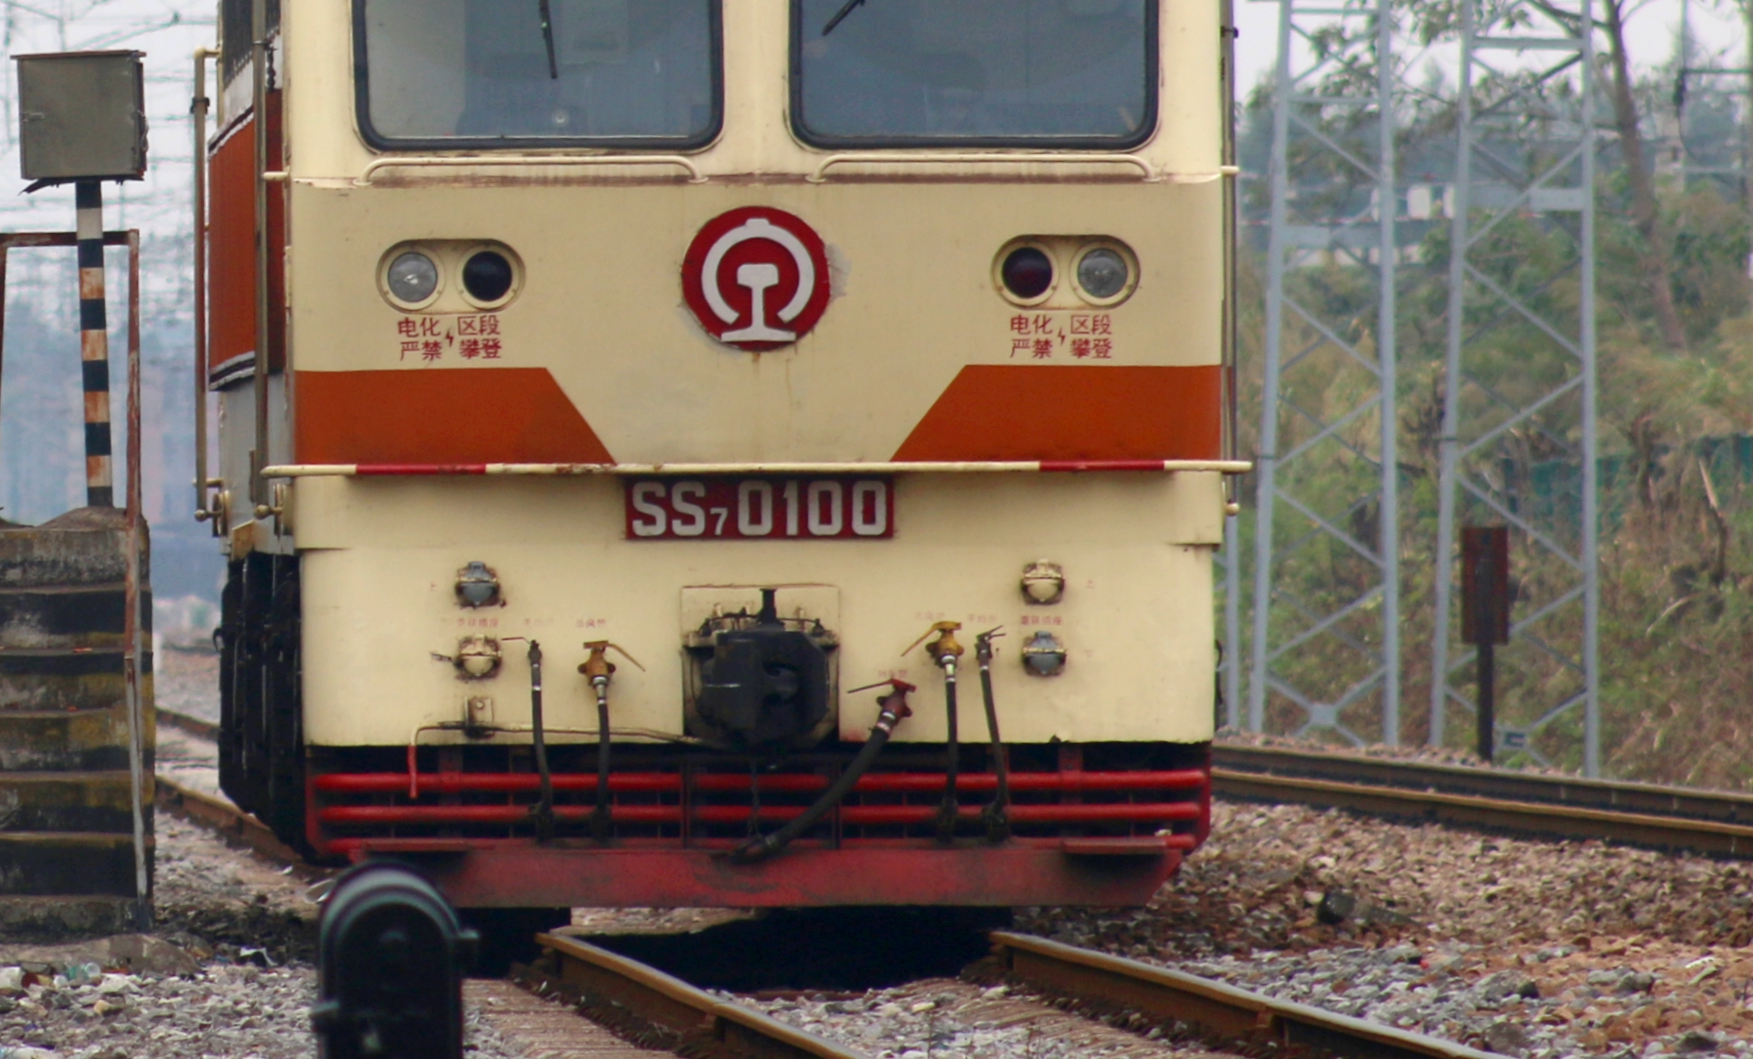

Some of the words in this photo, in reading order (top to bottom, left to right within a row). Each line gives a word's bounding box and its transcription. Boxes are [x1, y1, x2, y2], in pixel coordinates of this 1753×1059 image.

[397, 316, 442, 338] 电化
[457, 314, 501, 336] 区段
[1010, 314, 1053, 335] 电化
[1070, 314, 1112, 335] 区段
[399, 340, 443, 361] 严禁
[459, 337, 502, 359] 攀登
[1009, 338, 1053, 359] 严禁
[1070, 337, 1112, 359] 攀登
[631, 480, 887, 536] SS70100
